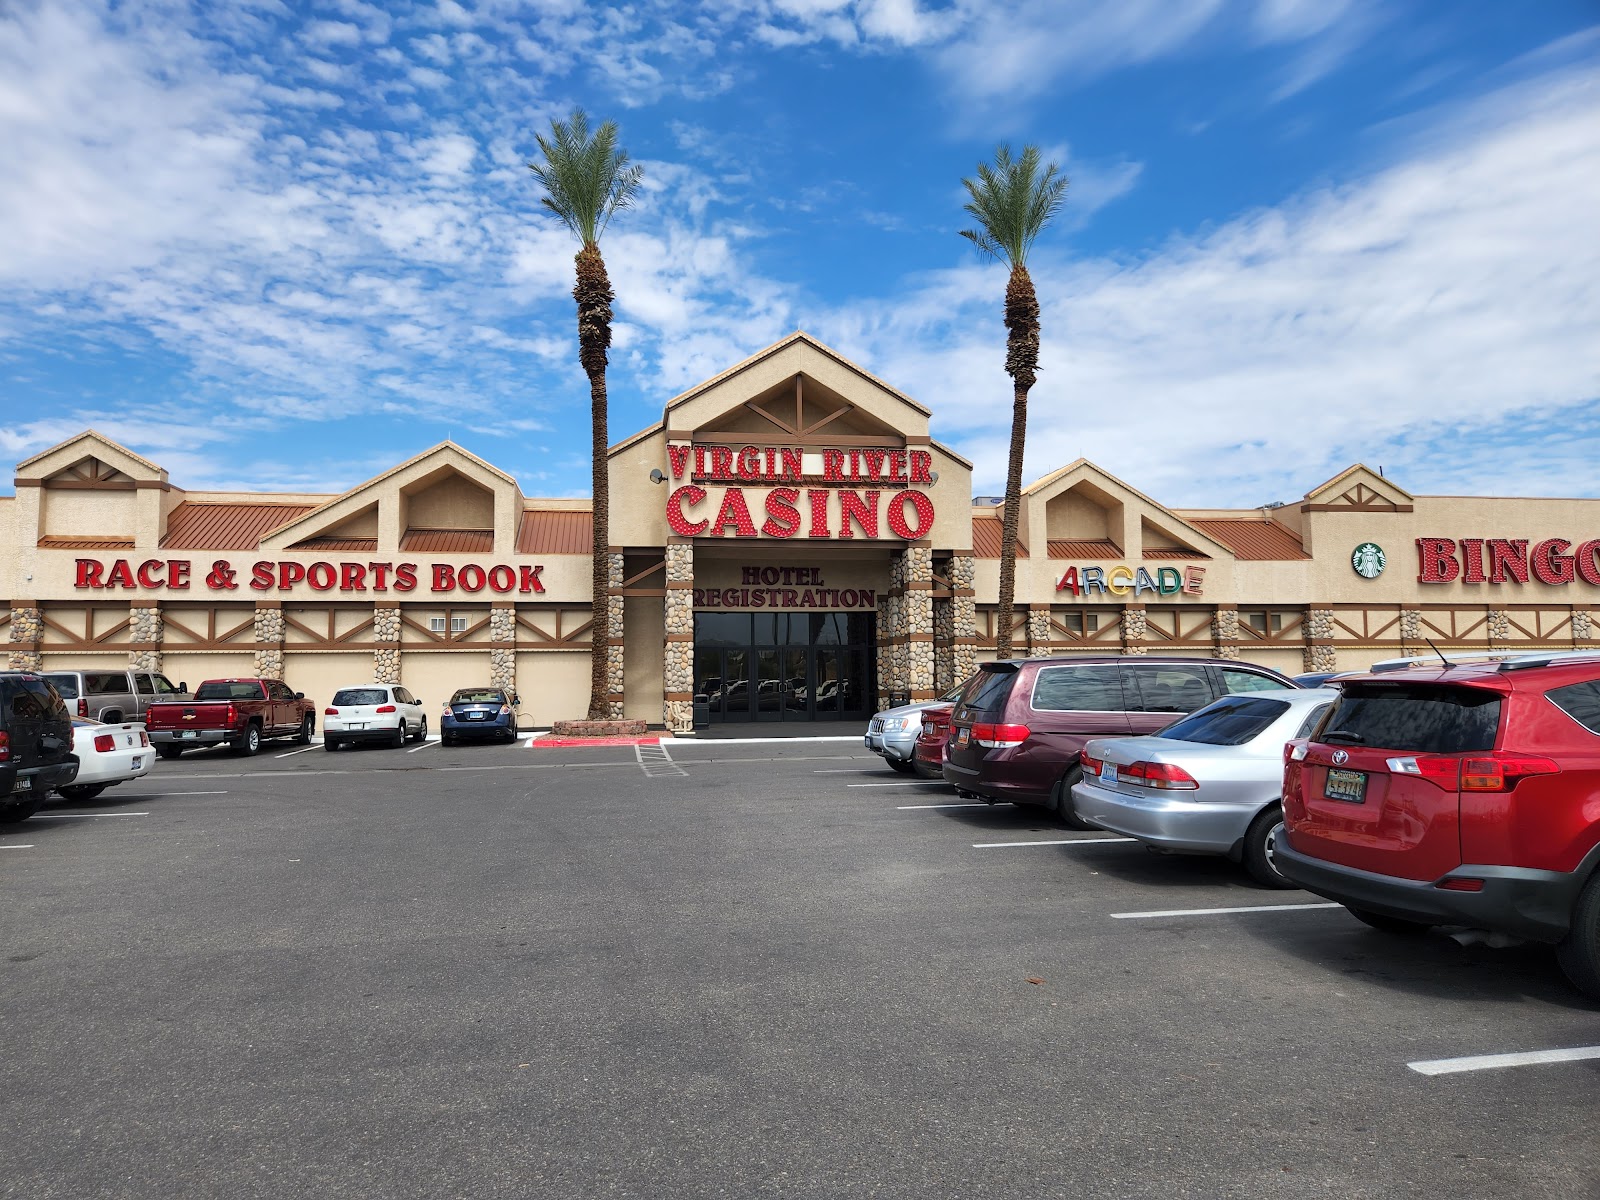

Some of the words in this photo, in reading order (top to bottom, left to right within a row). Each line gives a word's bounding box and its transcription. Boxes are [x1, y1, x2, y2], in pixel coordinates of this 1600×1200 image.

[666, 444, 804, 481] VIRGIN
[822, 447, 933, 484] RIVER
[665, 484, 935, 541] CASINO
[73, 558, 191, 590] RACE
[205, 559, 240, 591] &
[249, 560, 418, 592] SPORTS
[430, 563, 546, 594] BOOK
[741, 566, 825, 586] HOTEL
[1055, 565, 1207, 597] ARCADE
[693, 588, 876, 608] REGISTRATION
